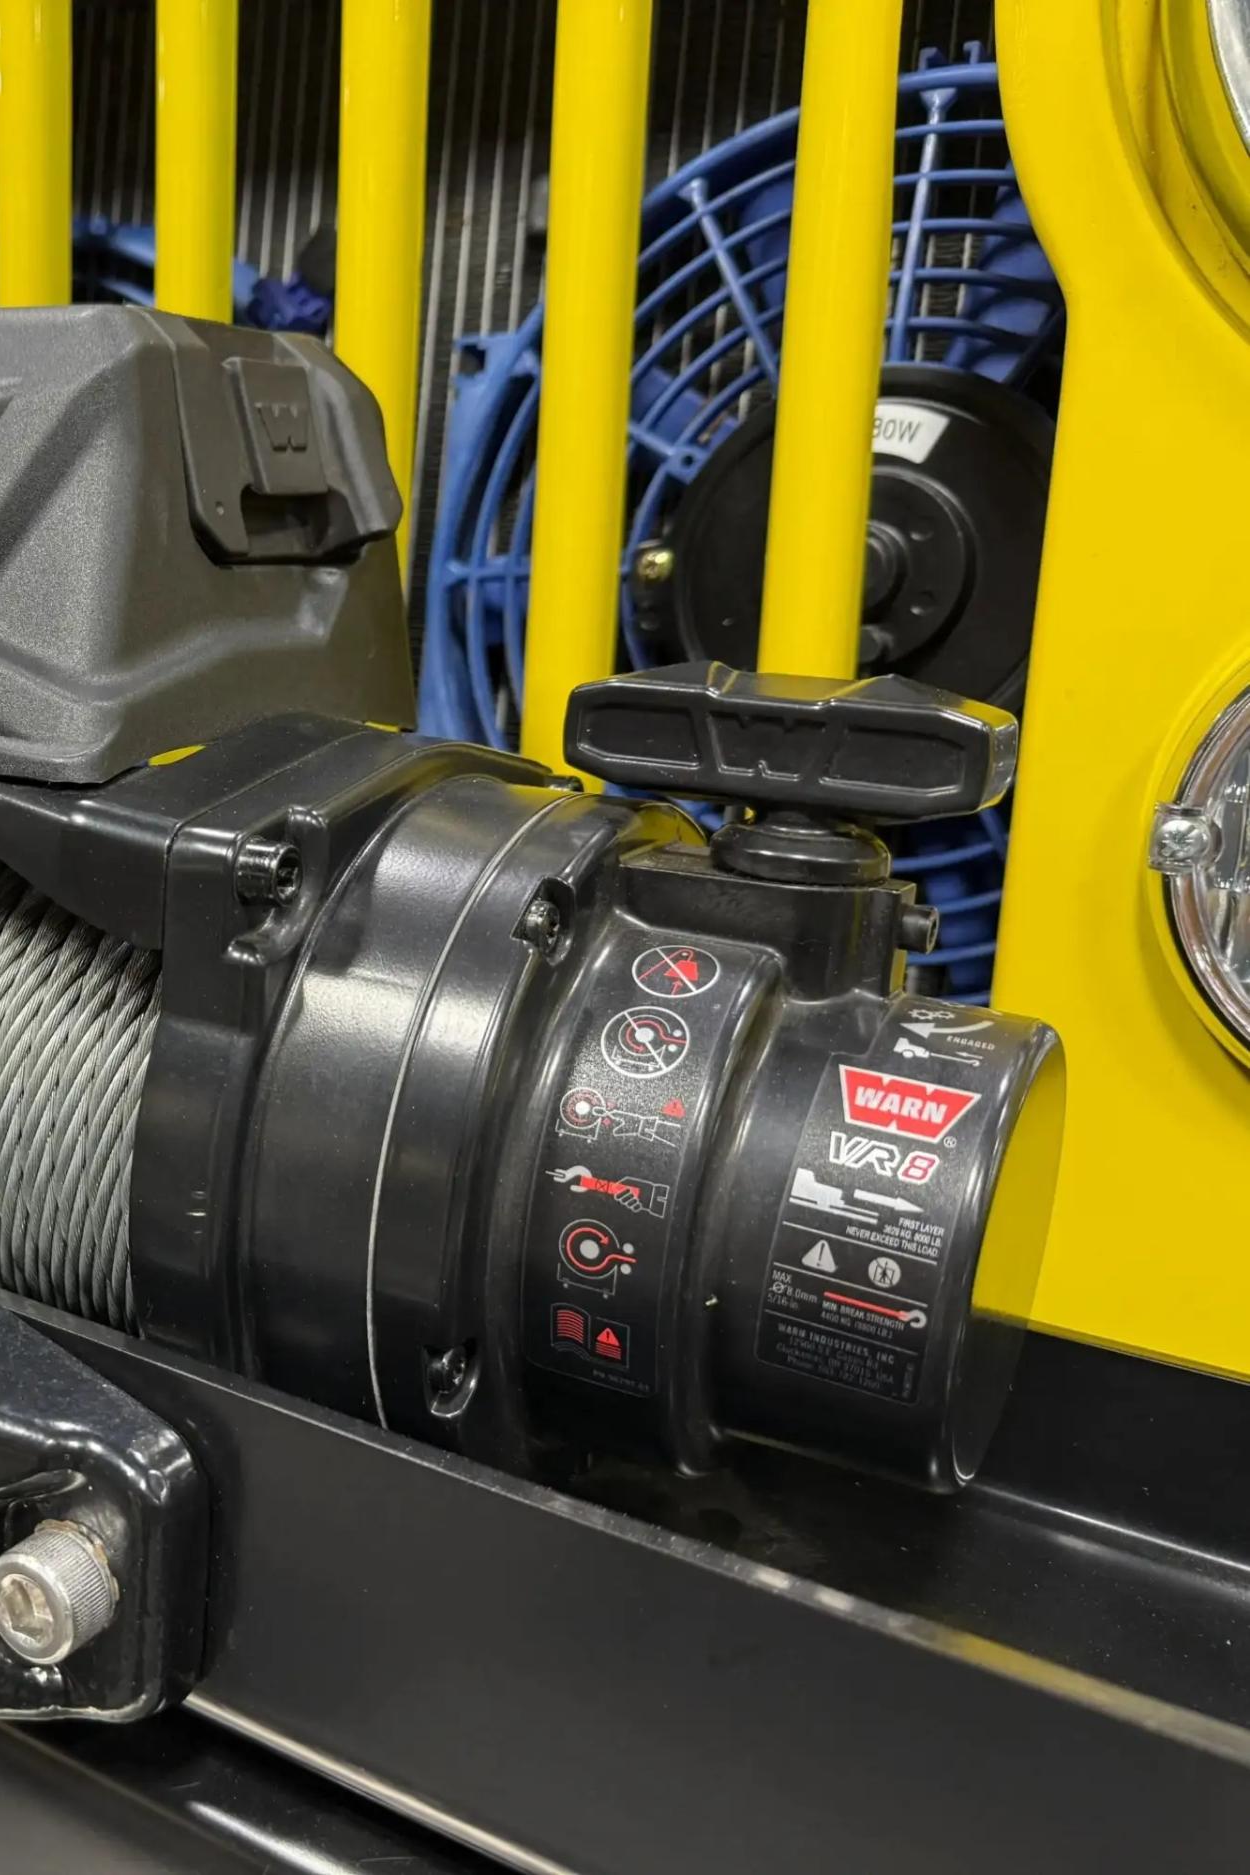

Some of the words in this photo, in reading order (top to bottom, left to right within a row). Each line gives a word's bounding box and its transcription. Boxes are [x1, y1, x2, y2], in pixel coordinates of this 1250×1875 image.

[946, 1035, 996, 1050] ENGAGED
[854, 1085, 948, 1124] WARN
[898, 1216, 920, 1230] FIRST
[920, 1222, 945, 1236] LAYER
[845, 1225, 871, 1240] NEVER
[870, 1231, 900, 1248] EXCEED
[901, 1240, 917, 1252] THIS
[772, 1269, 793, 1284] MAX
[777, 1321, 806, 1338] WARN
